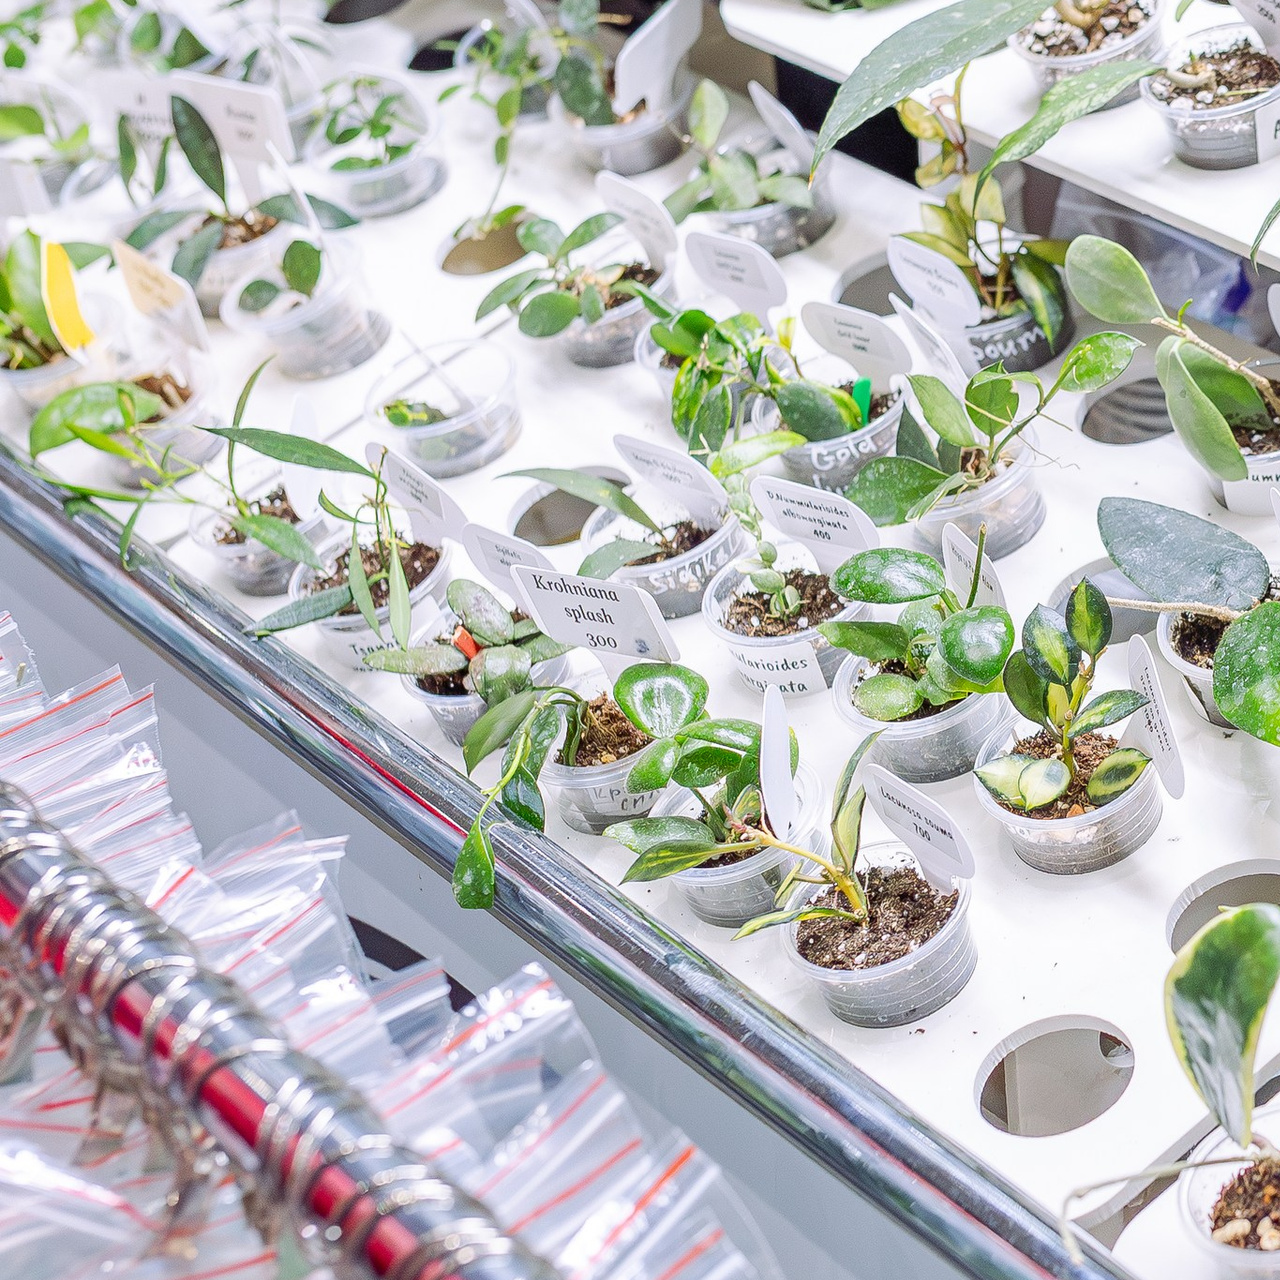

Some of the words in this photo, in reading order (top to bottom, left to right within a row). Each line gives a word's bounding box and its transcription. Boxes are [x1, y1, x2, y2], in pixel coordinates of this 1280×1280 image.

[813, 529, 831, 541] 400
[533, 574, 621, 604] Krohniana
[564, 603, 616, 626] splash
[585, 631, 618, 650] 300
[912, 821, 932, 842] 700
